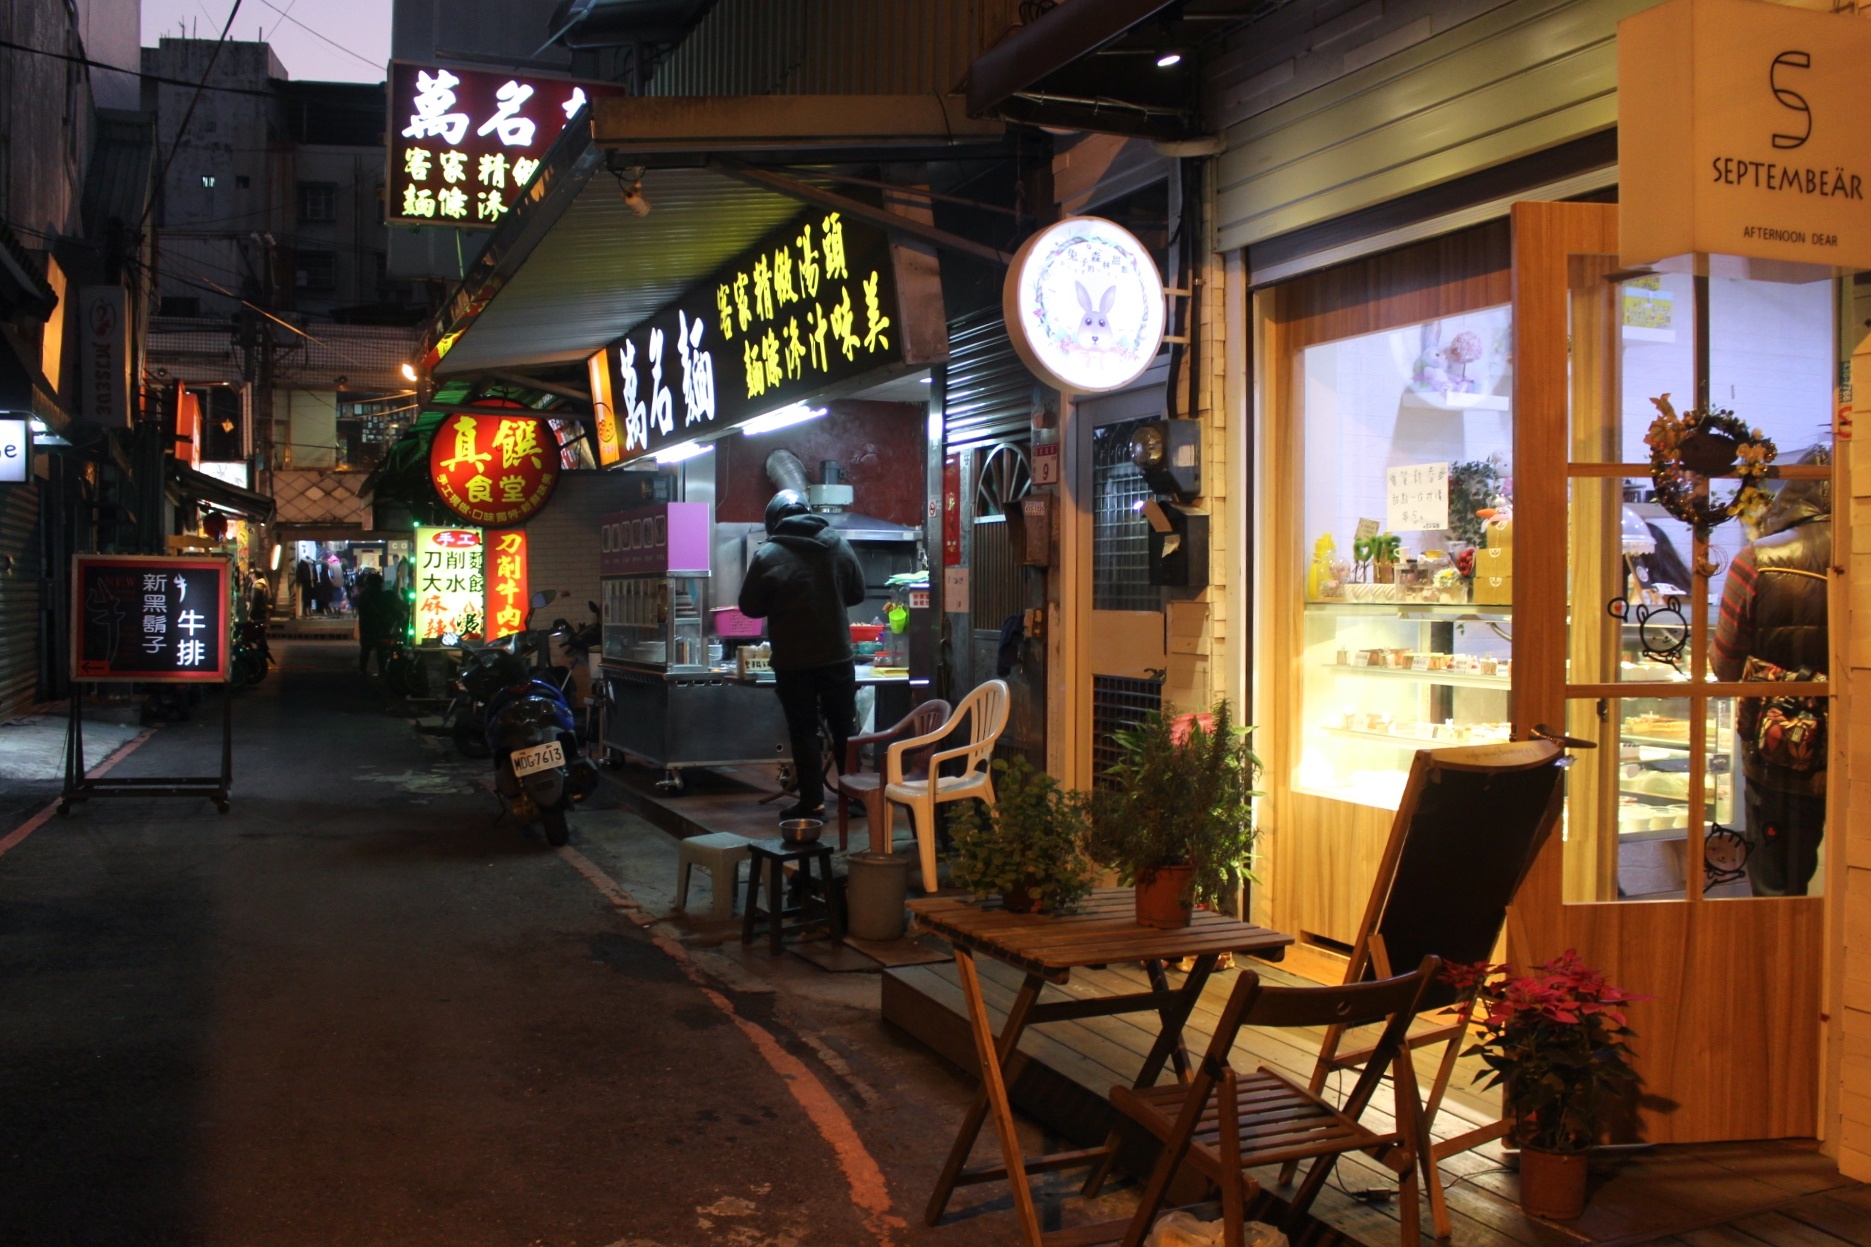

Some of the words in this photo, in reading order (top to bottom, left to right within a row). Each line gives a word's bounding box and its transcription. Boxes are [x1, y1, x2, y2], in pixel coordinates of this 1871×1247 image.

[1713, 156, 1864, 200] SEPTEMBEÄR
[1743, 226, 1806, 244] AFTERNOON
[1811, 232, 1838, 246] DEAR
[716, 211, 849, 340] 客家精做湯頭
[743, 271, 891, 399] 麵條滲汁味美
[439, 415, 543, 474] 真饌
[465, 474, 527, 503] 食堂
[1042, 462, 1049, 481] 9
[437, 532, 476, 547] 手工
[176, 609, 206, 667] 牛排
[513, 747, 562, 771] MDG-7613
